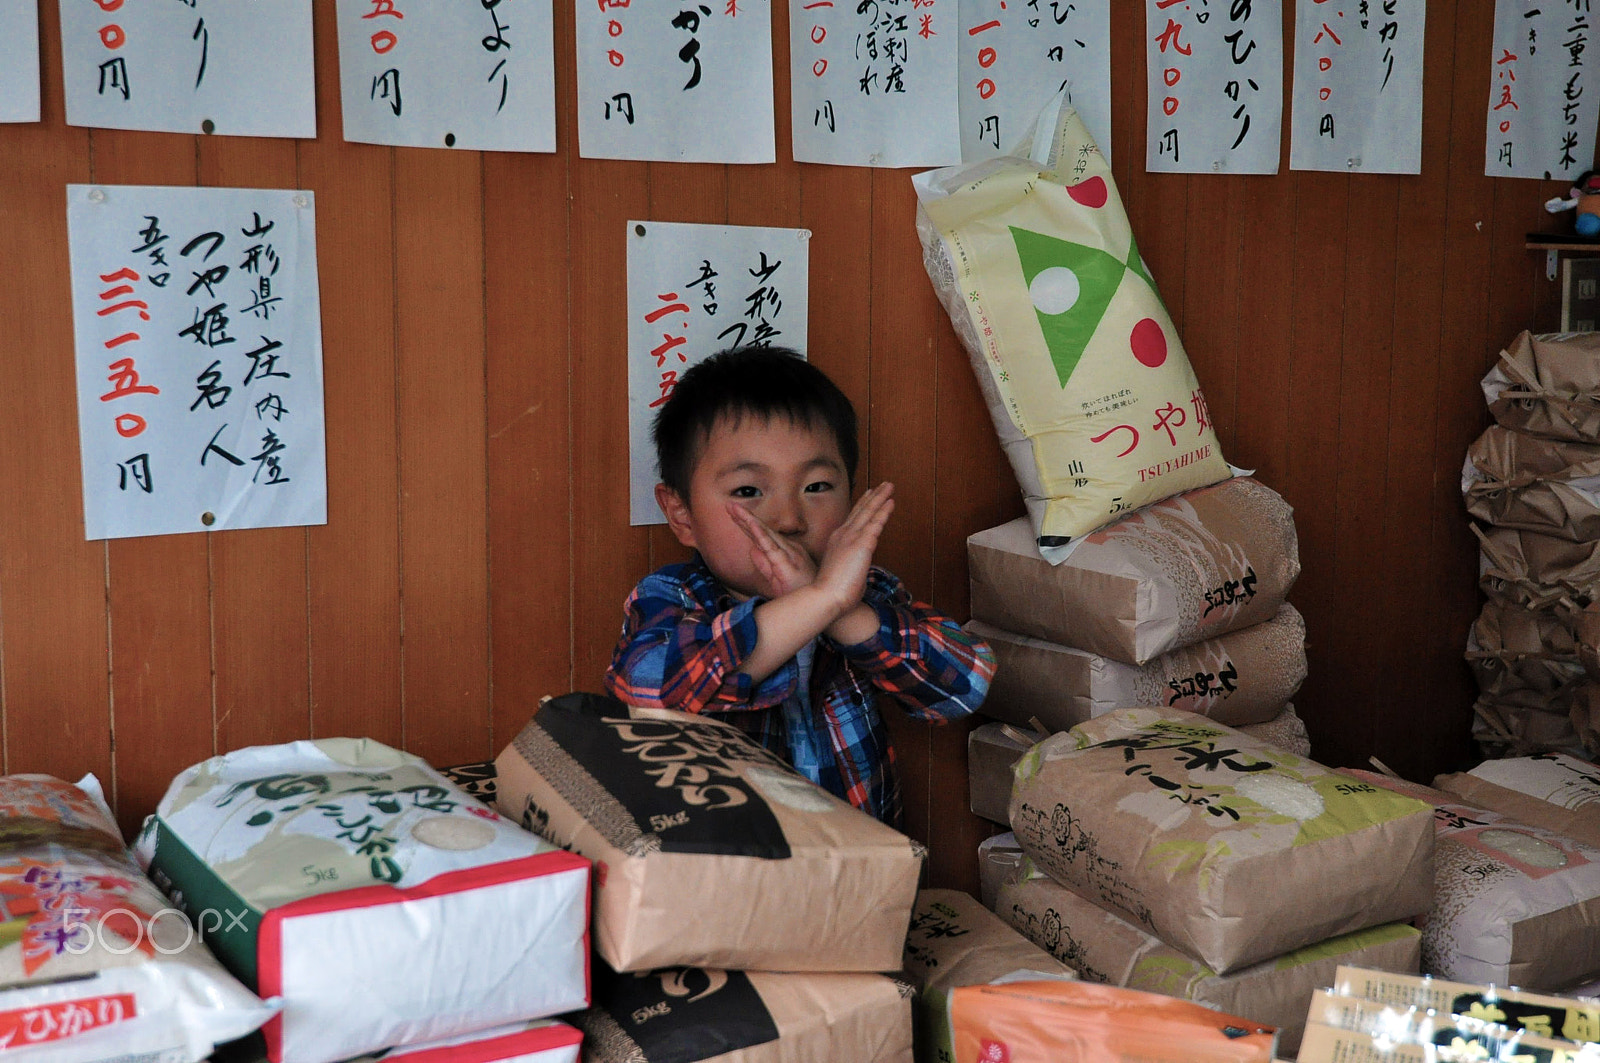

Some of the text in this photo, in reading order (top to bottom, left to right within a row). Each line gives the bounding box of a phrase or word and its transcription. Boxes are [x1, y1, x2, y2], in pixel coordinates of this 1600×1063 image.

[880, 0, 909, 93] 江刺産
[1137, 444, 1212, 483] TSUYAHIME
[1335, 783, 1376, 797] 5kg
[649, 810, 691, 833] 5kg
[631, 1001, 671, 1025] 5kg
